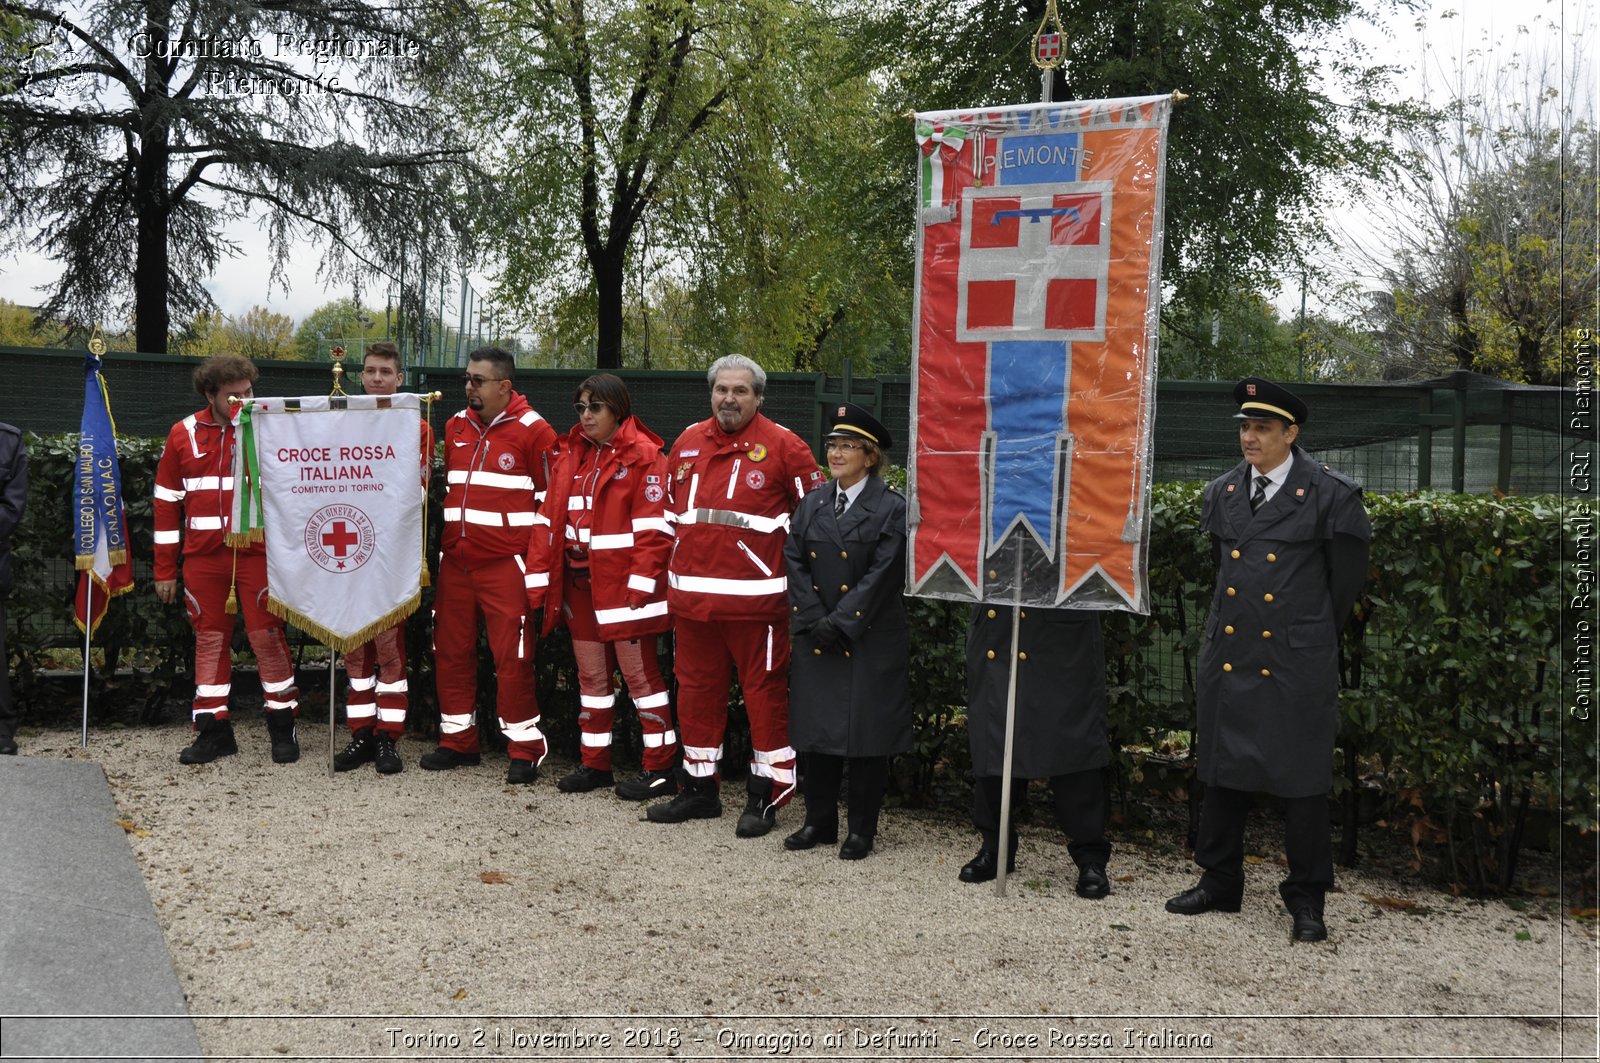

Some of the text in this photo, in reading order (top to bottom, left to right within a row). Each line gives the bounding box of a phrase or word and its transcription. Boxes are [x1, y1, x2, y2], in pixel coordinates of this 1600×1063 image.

[80, 443, 94, 474] MAURO
[277, 445, 396, 462] CROCE ROSSA
[300, 465, 374, 481] ITALIANA
[81, 476, 94, 494] SAN
[291, 483, 384, 494] COMITATO DI TORINO
[316, 512, 326, 523] DI
[325, 506, 358, 520] GINEVRA
[81, 507, 95, 549] COLLEGIO
[307, 520, 330, 566] CONVENZIONE
[361, 525, 373, 552] AGOSTO
